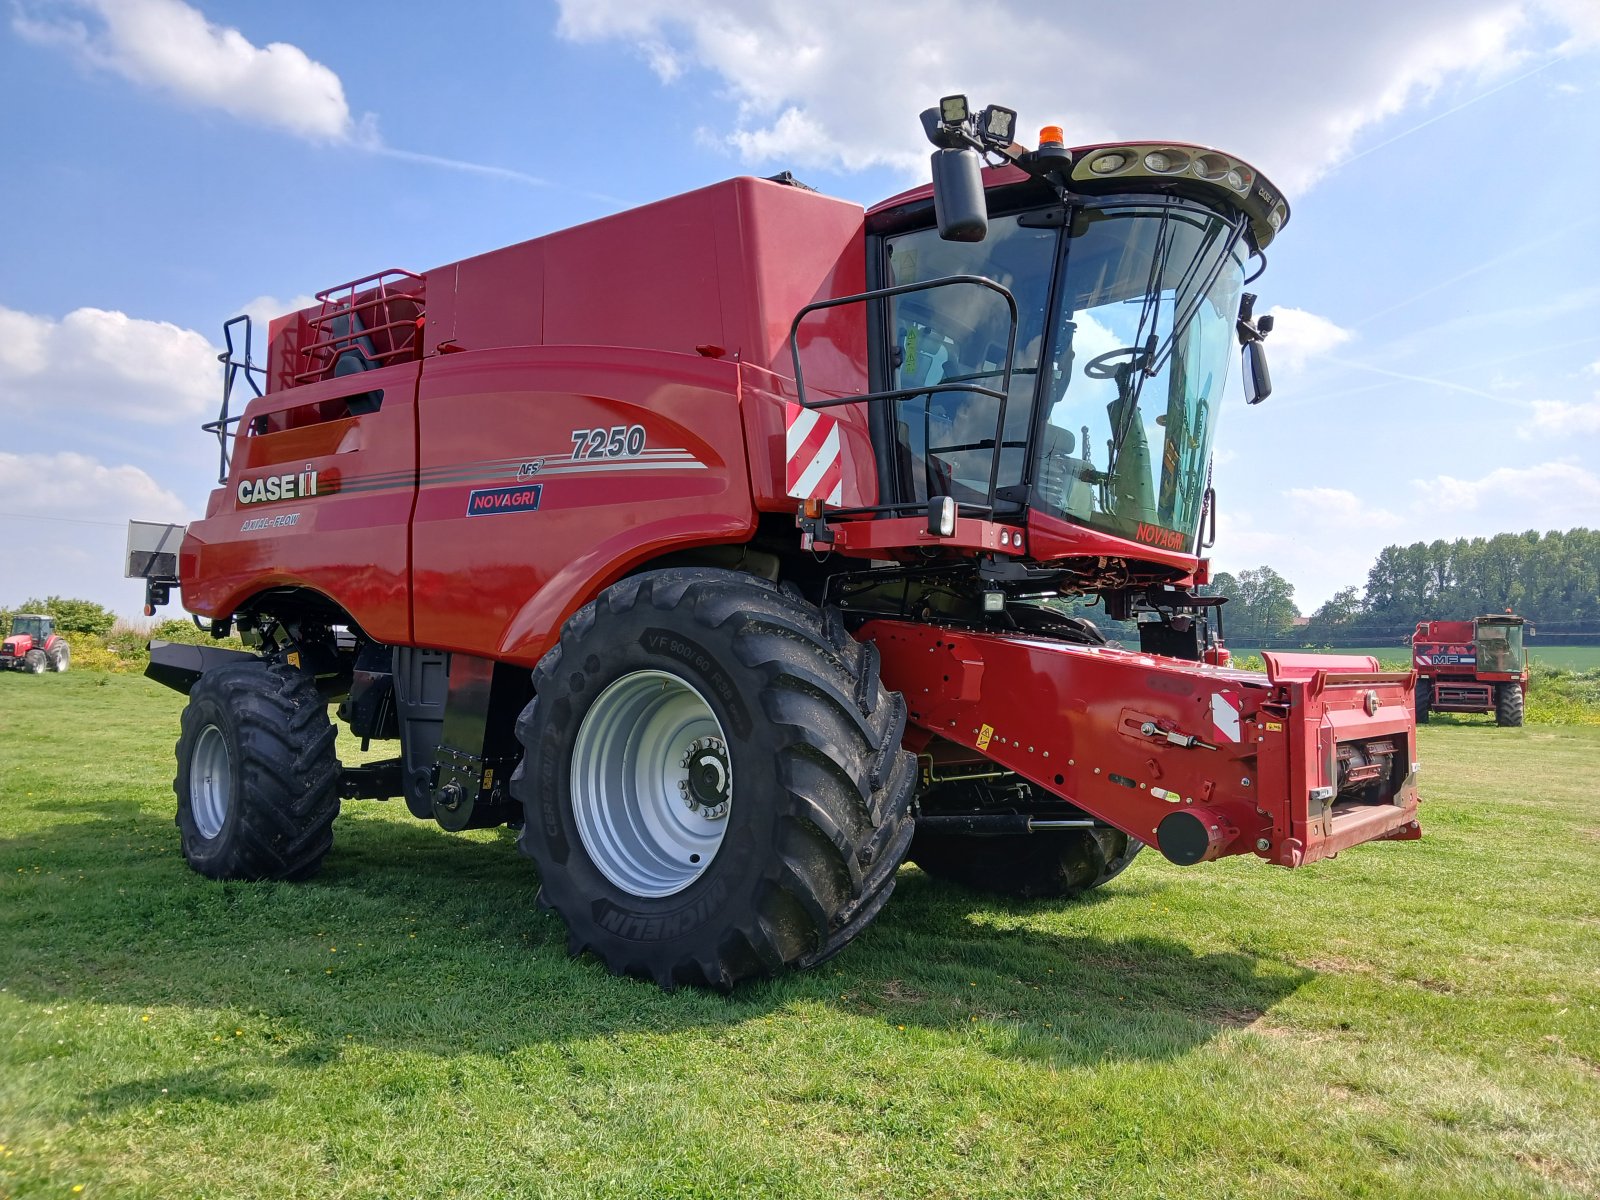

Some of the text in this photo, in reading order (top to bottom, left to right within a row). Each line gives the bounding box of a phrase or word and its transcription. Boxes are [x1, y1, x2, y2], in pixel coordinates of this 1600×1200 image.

[571, 424, 646, 461] 7250
[518, 463, 540, 476] AFS
[237, 474, 295, 504] CASE
[474, 491, 535, 510] NOVAGRI
[240, 513, 301, 532] AXIAL-FLOW
[1135, 521, 1184, 550] NOVAGRI
[1432, 655, 1459, 665] MF
[600, 877, 728, 941] MICHELIN
